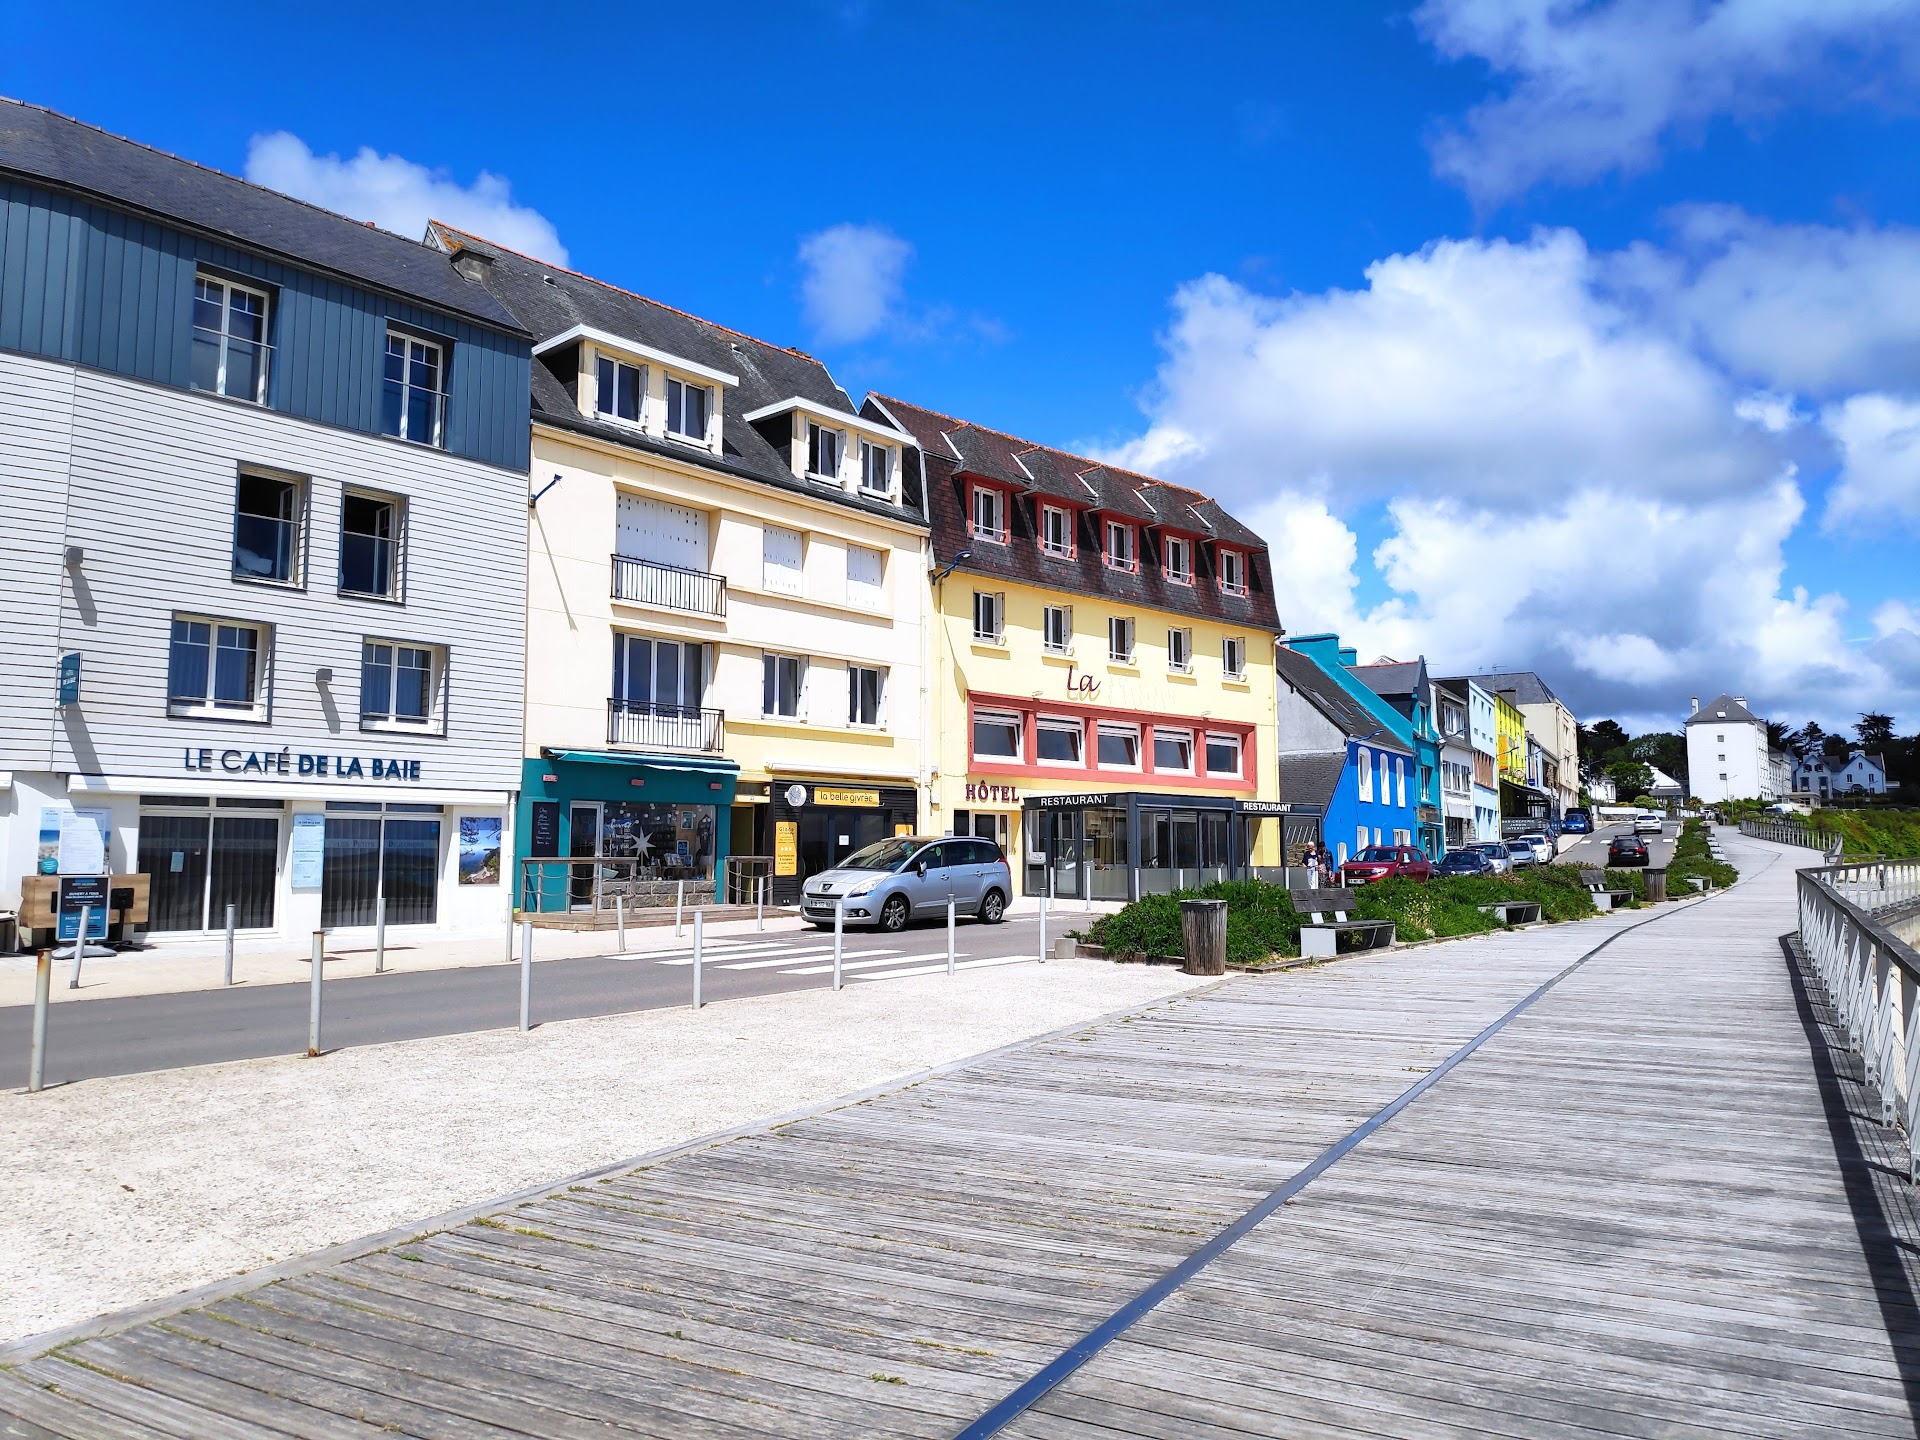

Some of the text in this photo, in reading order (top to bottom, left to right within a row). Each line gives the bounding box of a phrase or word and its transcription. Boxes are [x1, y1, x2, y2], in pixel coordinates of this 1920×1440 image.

[1066, 664, 1102, 692] La
[184, 746, 421, 781] LE CAFÉ DE LA BAIE
[830, 792, 849, 801] belle
[965, 779, 1020, 803] HÔTEL
[1040, 794, 1109, 807] RESTAURANT
[1243, 802, 1292, 812] RESTAURANT
